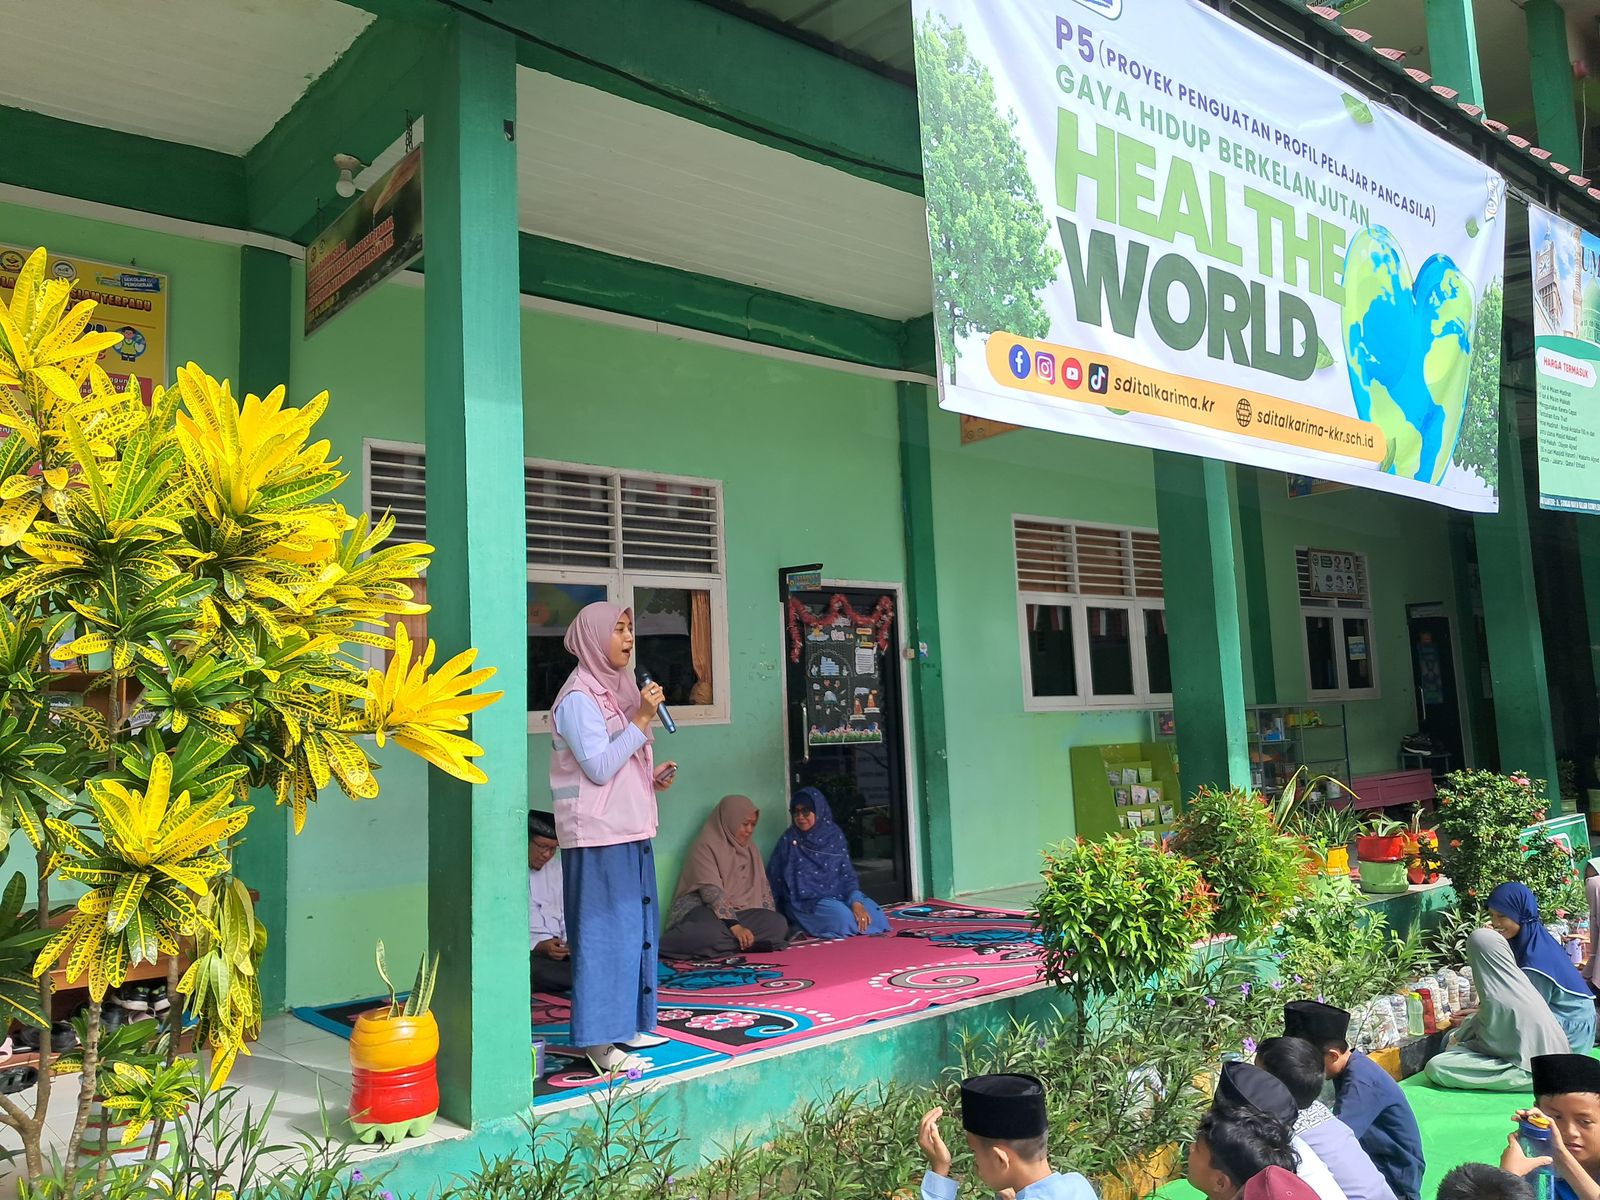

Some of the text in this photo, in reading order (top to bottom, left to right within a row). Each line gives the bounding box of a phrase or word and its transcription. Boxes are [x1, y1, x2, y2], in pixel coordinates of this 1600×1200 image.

[1055, 15, 1094, 62] P5
[1099, 39, 1173, 96] (PROYEK
[1179, 84, 1270, 142] PENGUATAN
[1275, 128, 1318, 165] PROFIL
[1321, 156, 1368, 189] PELAJAR
[1371, 181, 1436, 227] PANCASILA)
[1056, 64, 1370, 227] GAYA HIDUP BERKELANJUTAN
[1055, 106, 1346, 305] HEAL THE
[100, 292, 152, 312] TERPADU
[1056, 216, 1318, 381] WORLD
[1113, 374, 1215, 414] sditalkarima.kr
[1543, 356, 1589, 378] HARGA TERMASUK
[1256, 409, 1374, 448] sditalkarima-kkr.sch.id
